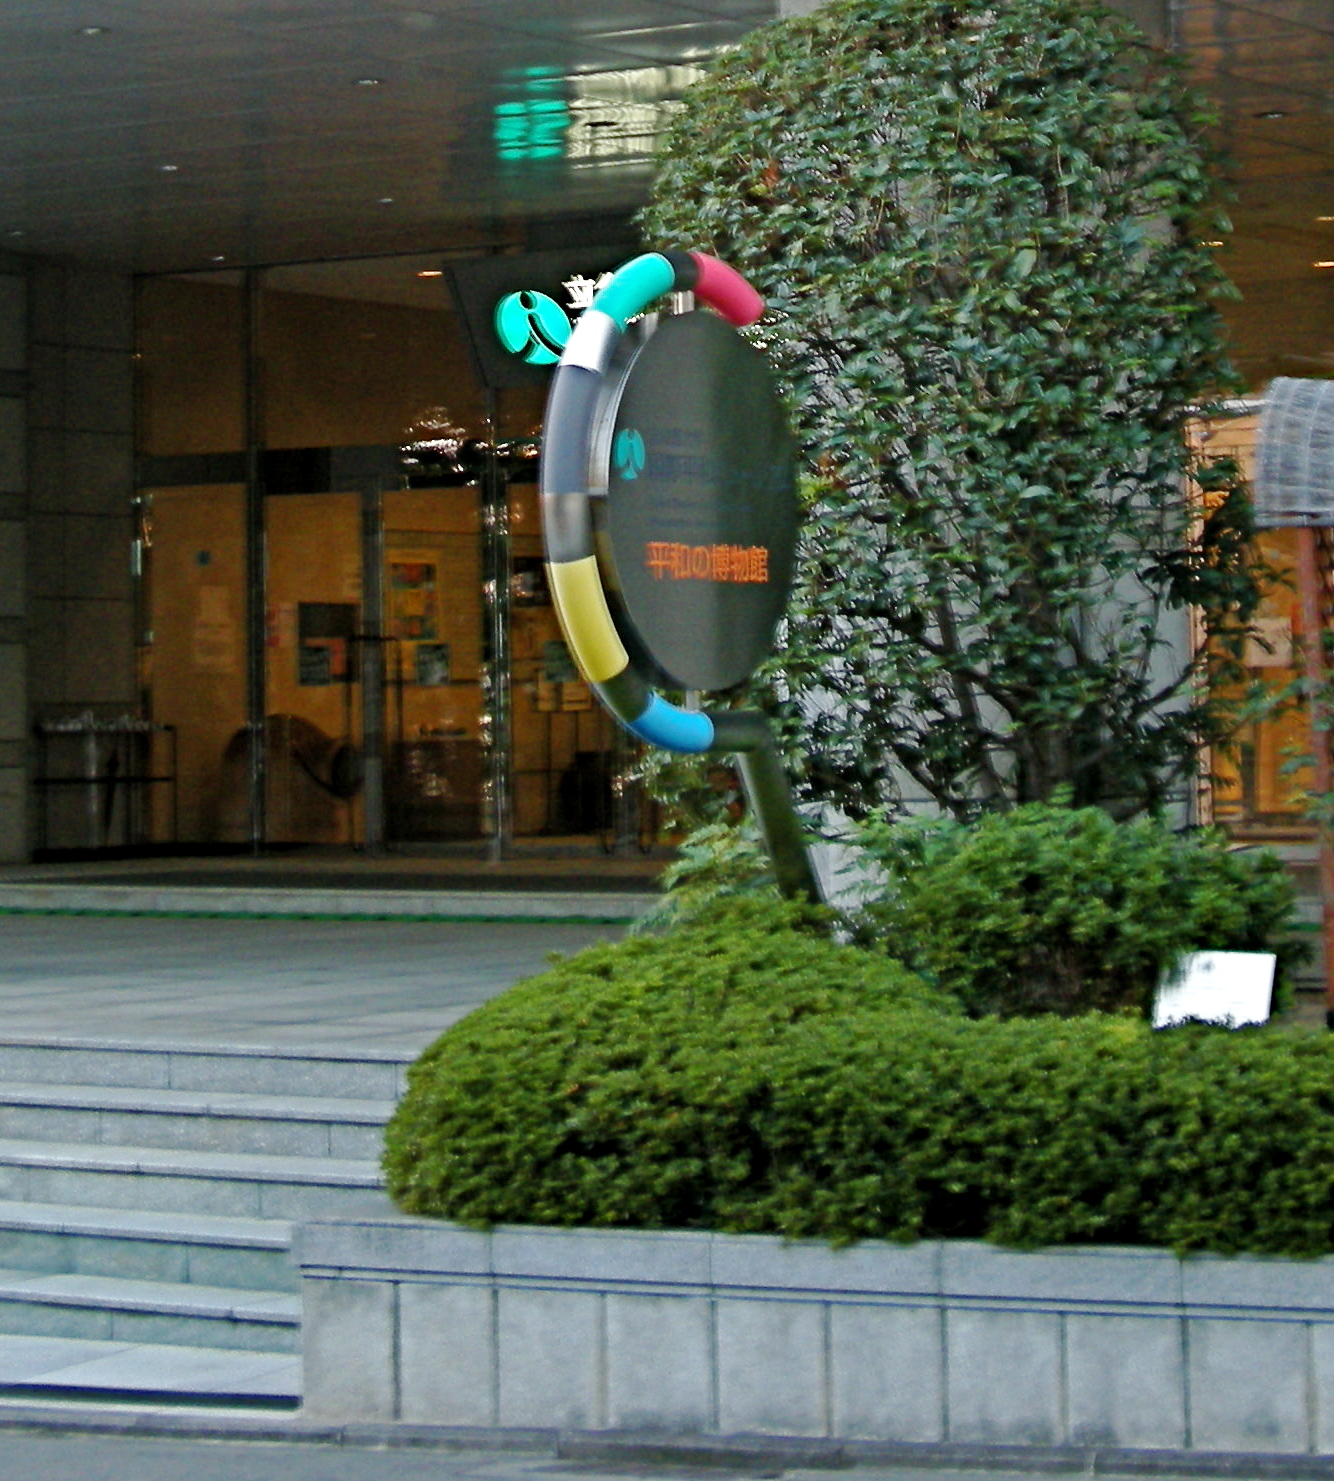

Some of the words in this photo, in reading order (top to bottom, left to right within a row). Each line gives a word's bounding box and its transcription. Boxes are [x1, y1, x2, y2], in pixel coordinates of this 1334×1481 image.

[646, 541, 768, 583] 平和の博物館
